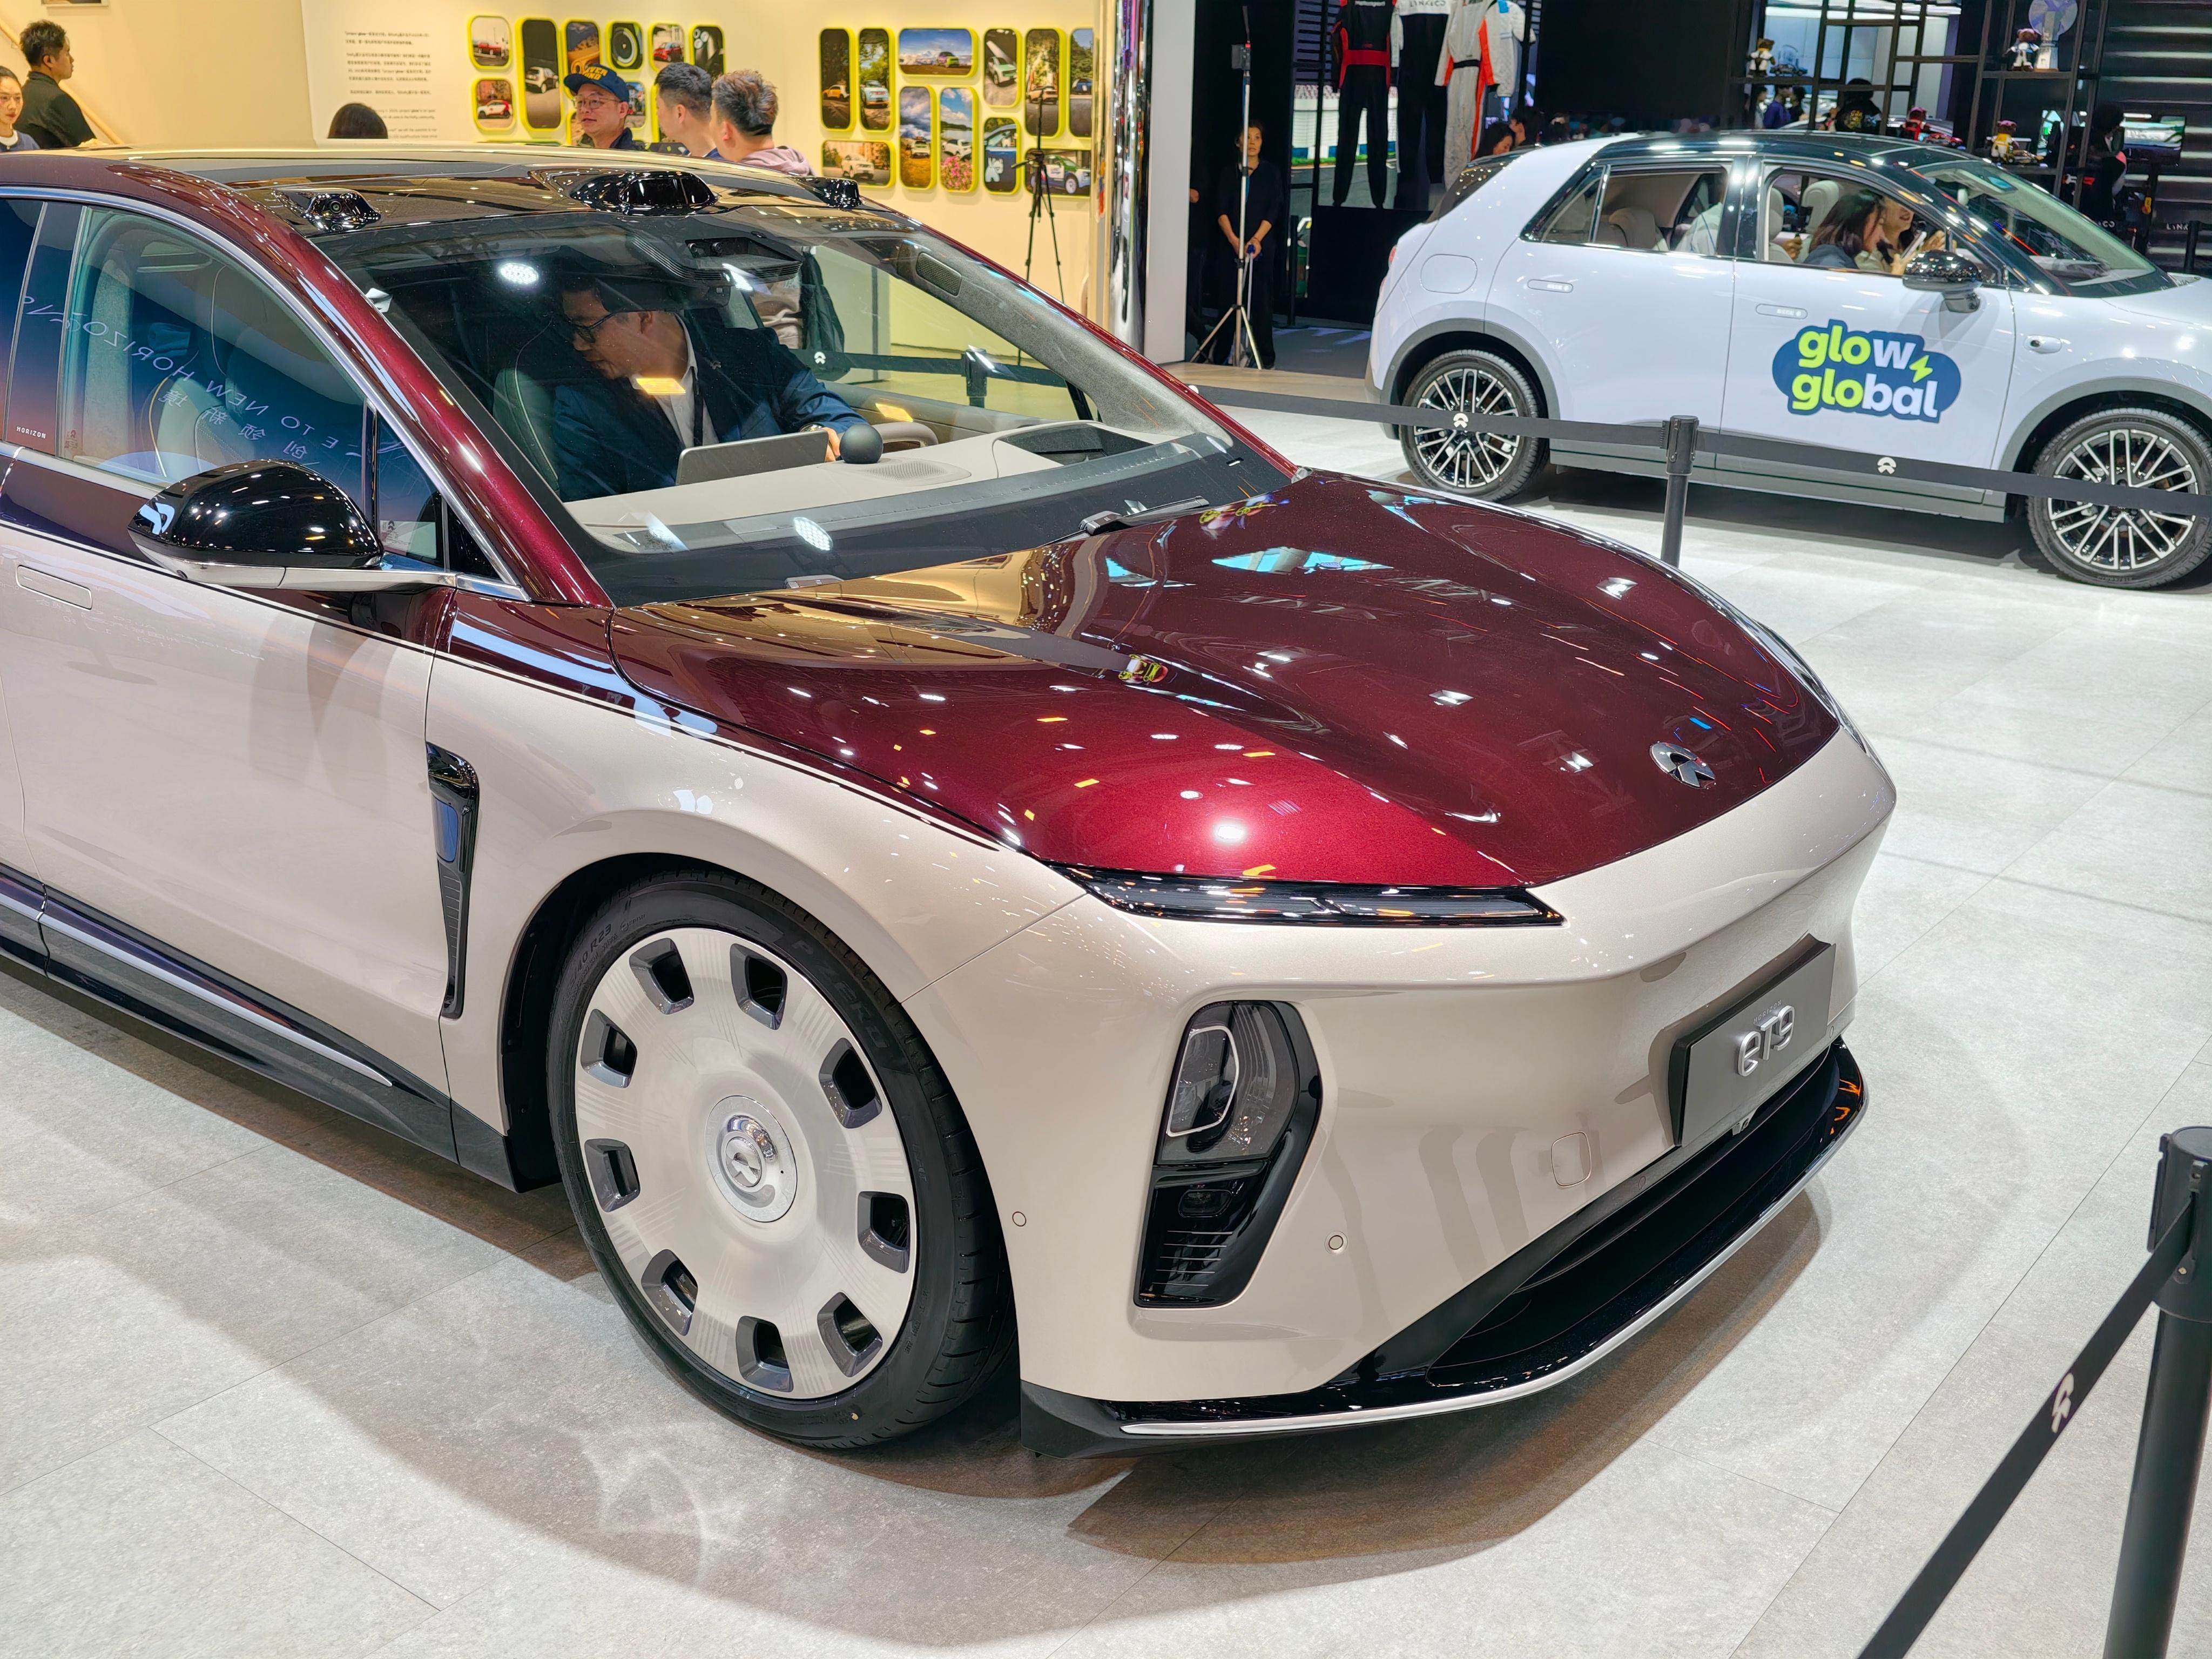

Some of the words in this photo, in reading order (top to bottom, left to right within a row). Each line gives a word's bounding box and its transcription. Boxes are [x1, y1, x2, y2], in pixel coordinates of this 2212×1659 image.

[1798, 325, 1917, 368] glow
[1791, 368, 1938, 418] global
[16, 426, 46, 439] HORIZON
[1753, 1000, 1782, 1024] HORIZON
